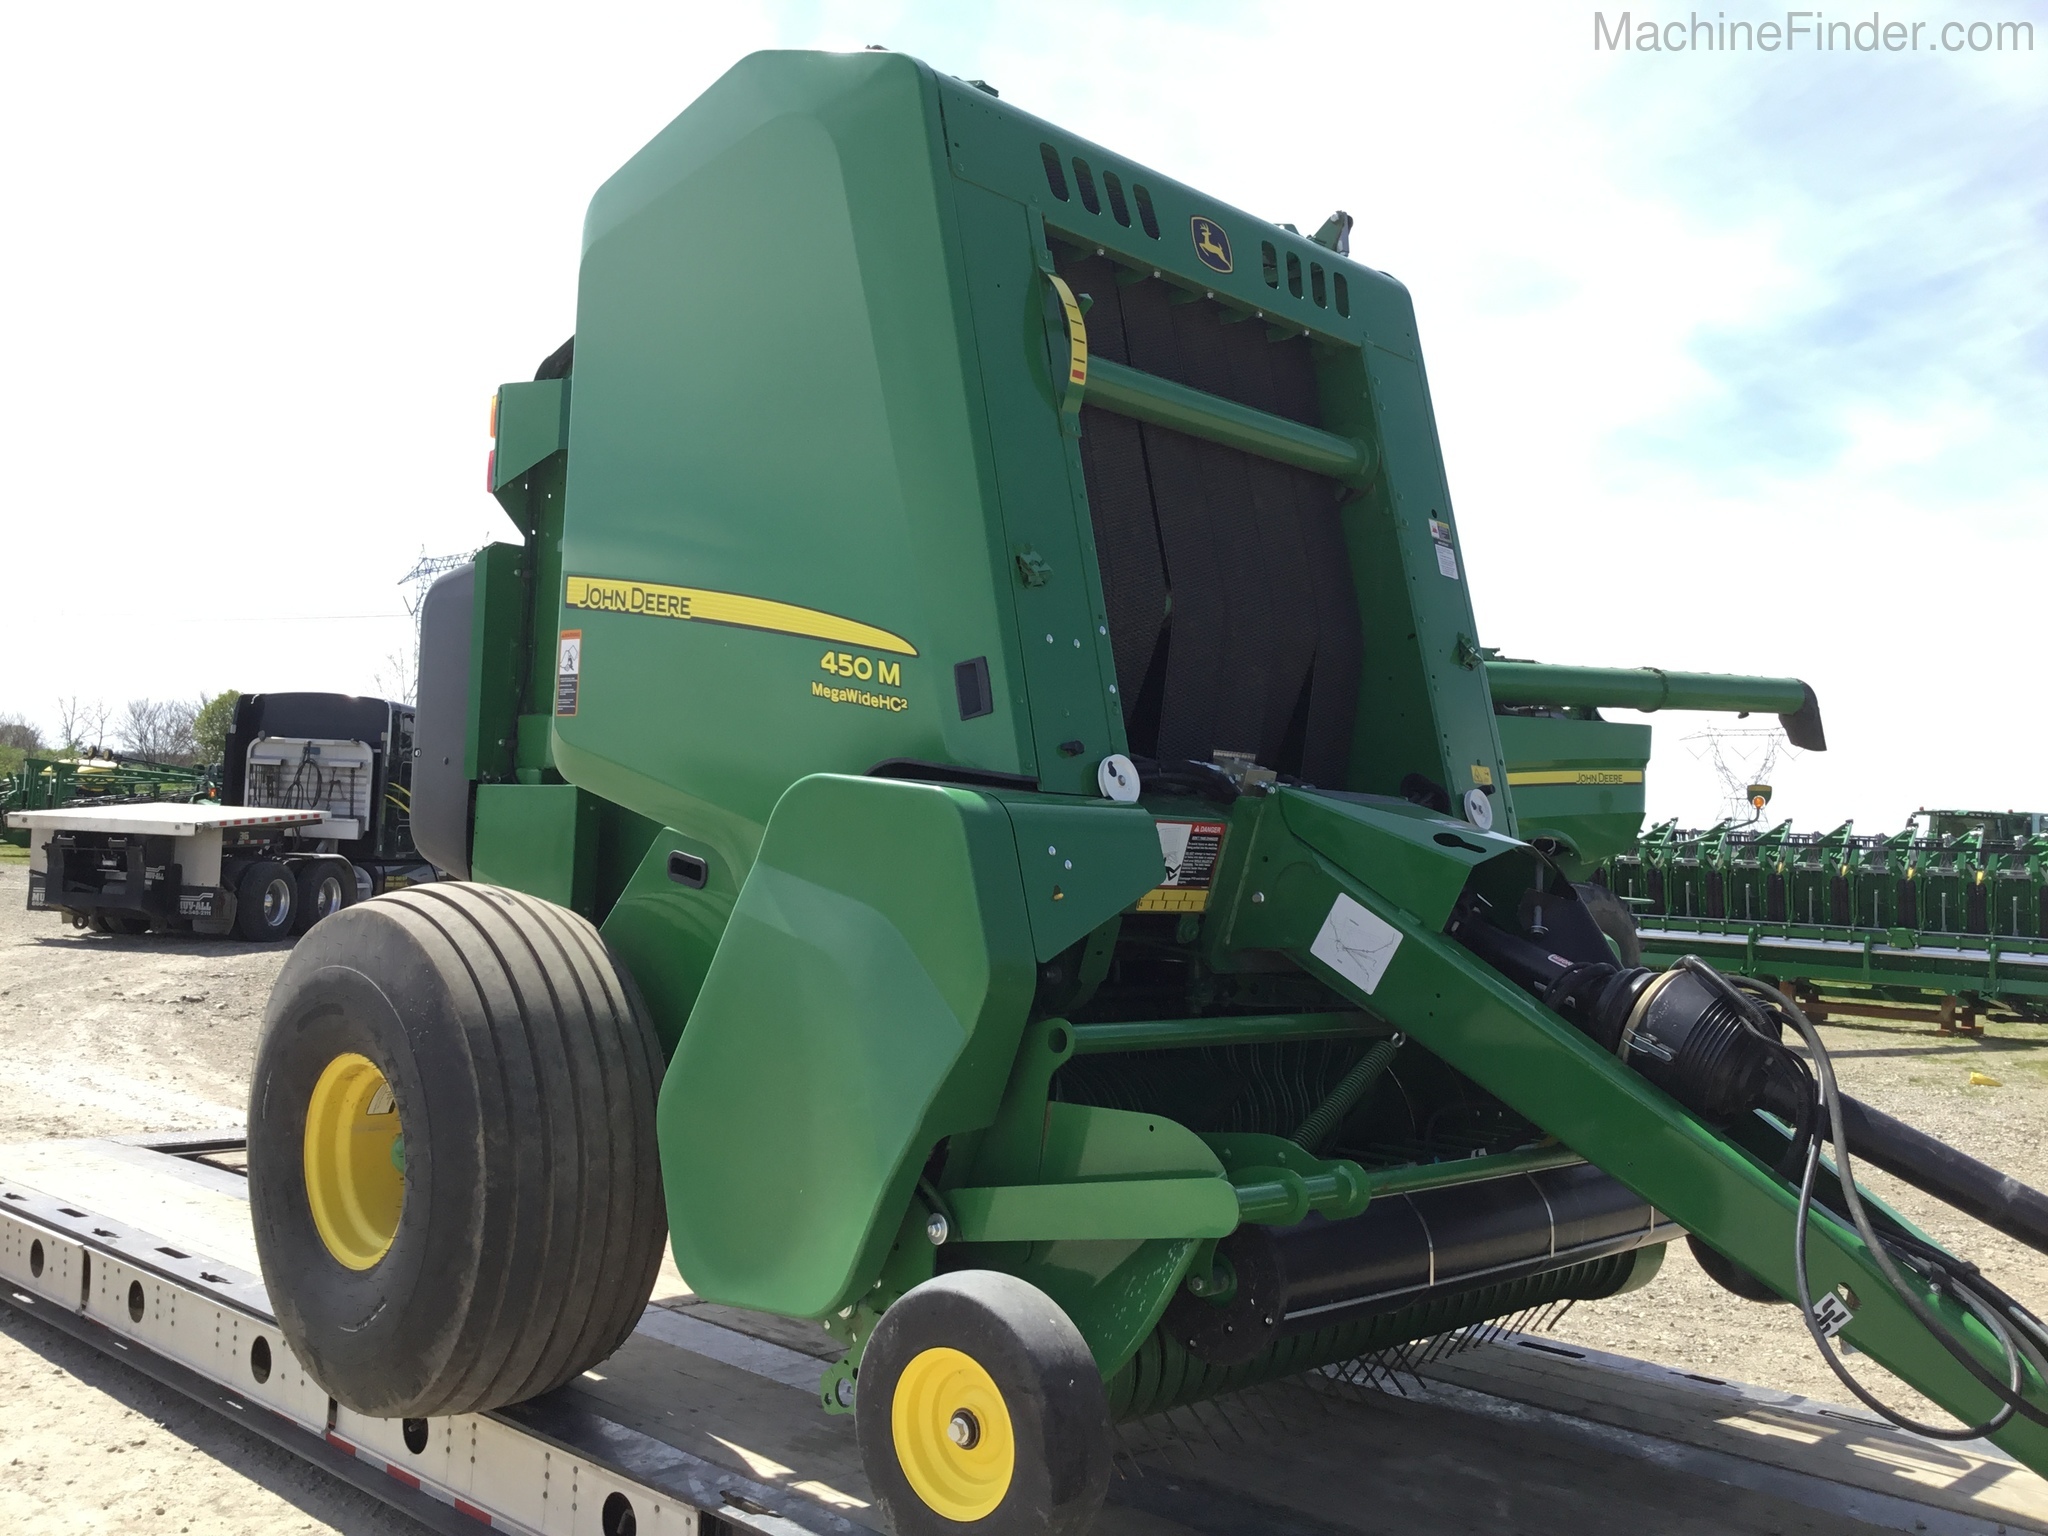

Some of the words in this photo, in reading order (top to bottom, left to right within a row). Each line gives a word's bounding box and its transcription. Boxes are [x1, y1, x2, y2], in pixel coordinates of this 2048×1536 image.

[579, 583, 627, 610] JOHN
[630, 587, 692, 616] DEERE
[820, 651, 873, 681] 450
[878, 660, 901, 687] M
[1576, 772, 1597, 783] JOHN
[1598, 772, 1623, 783] DEERE
[1200, 826, 1221, 834] DANGER
